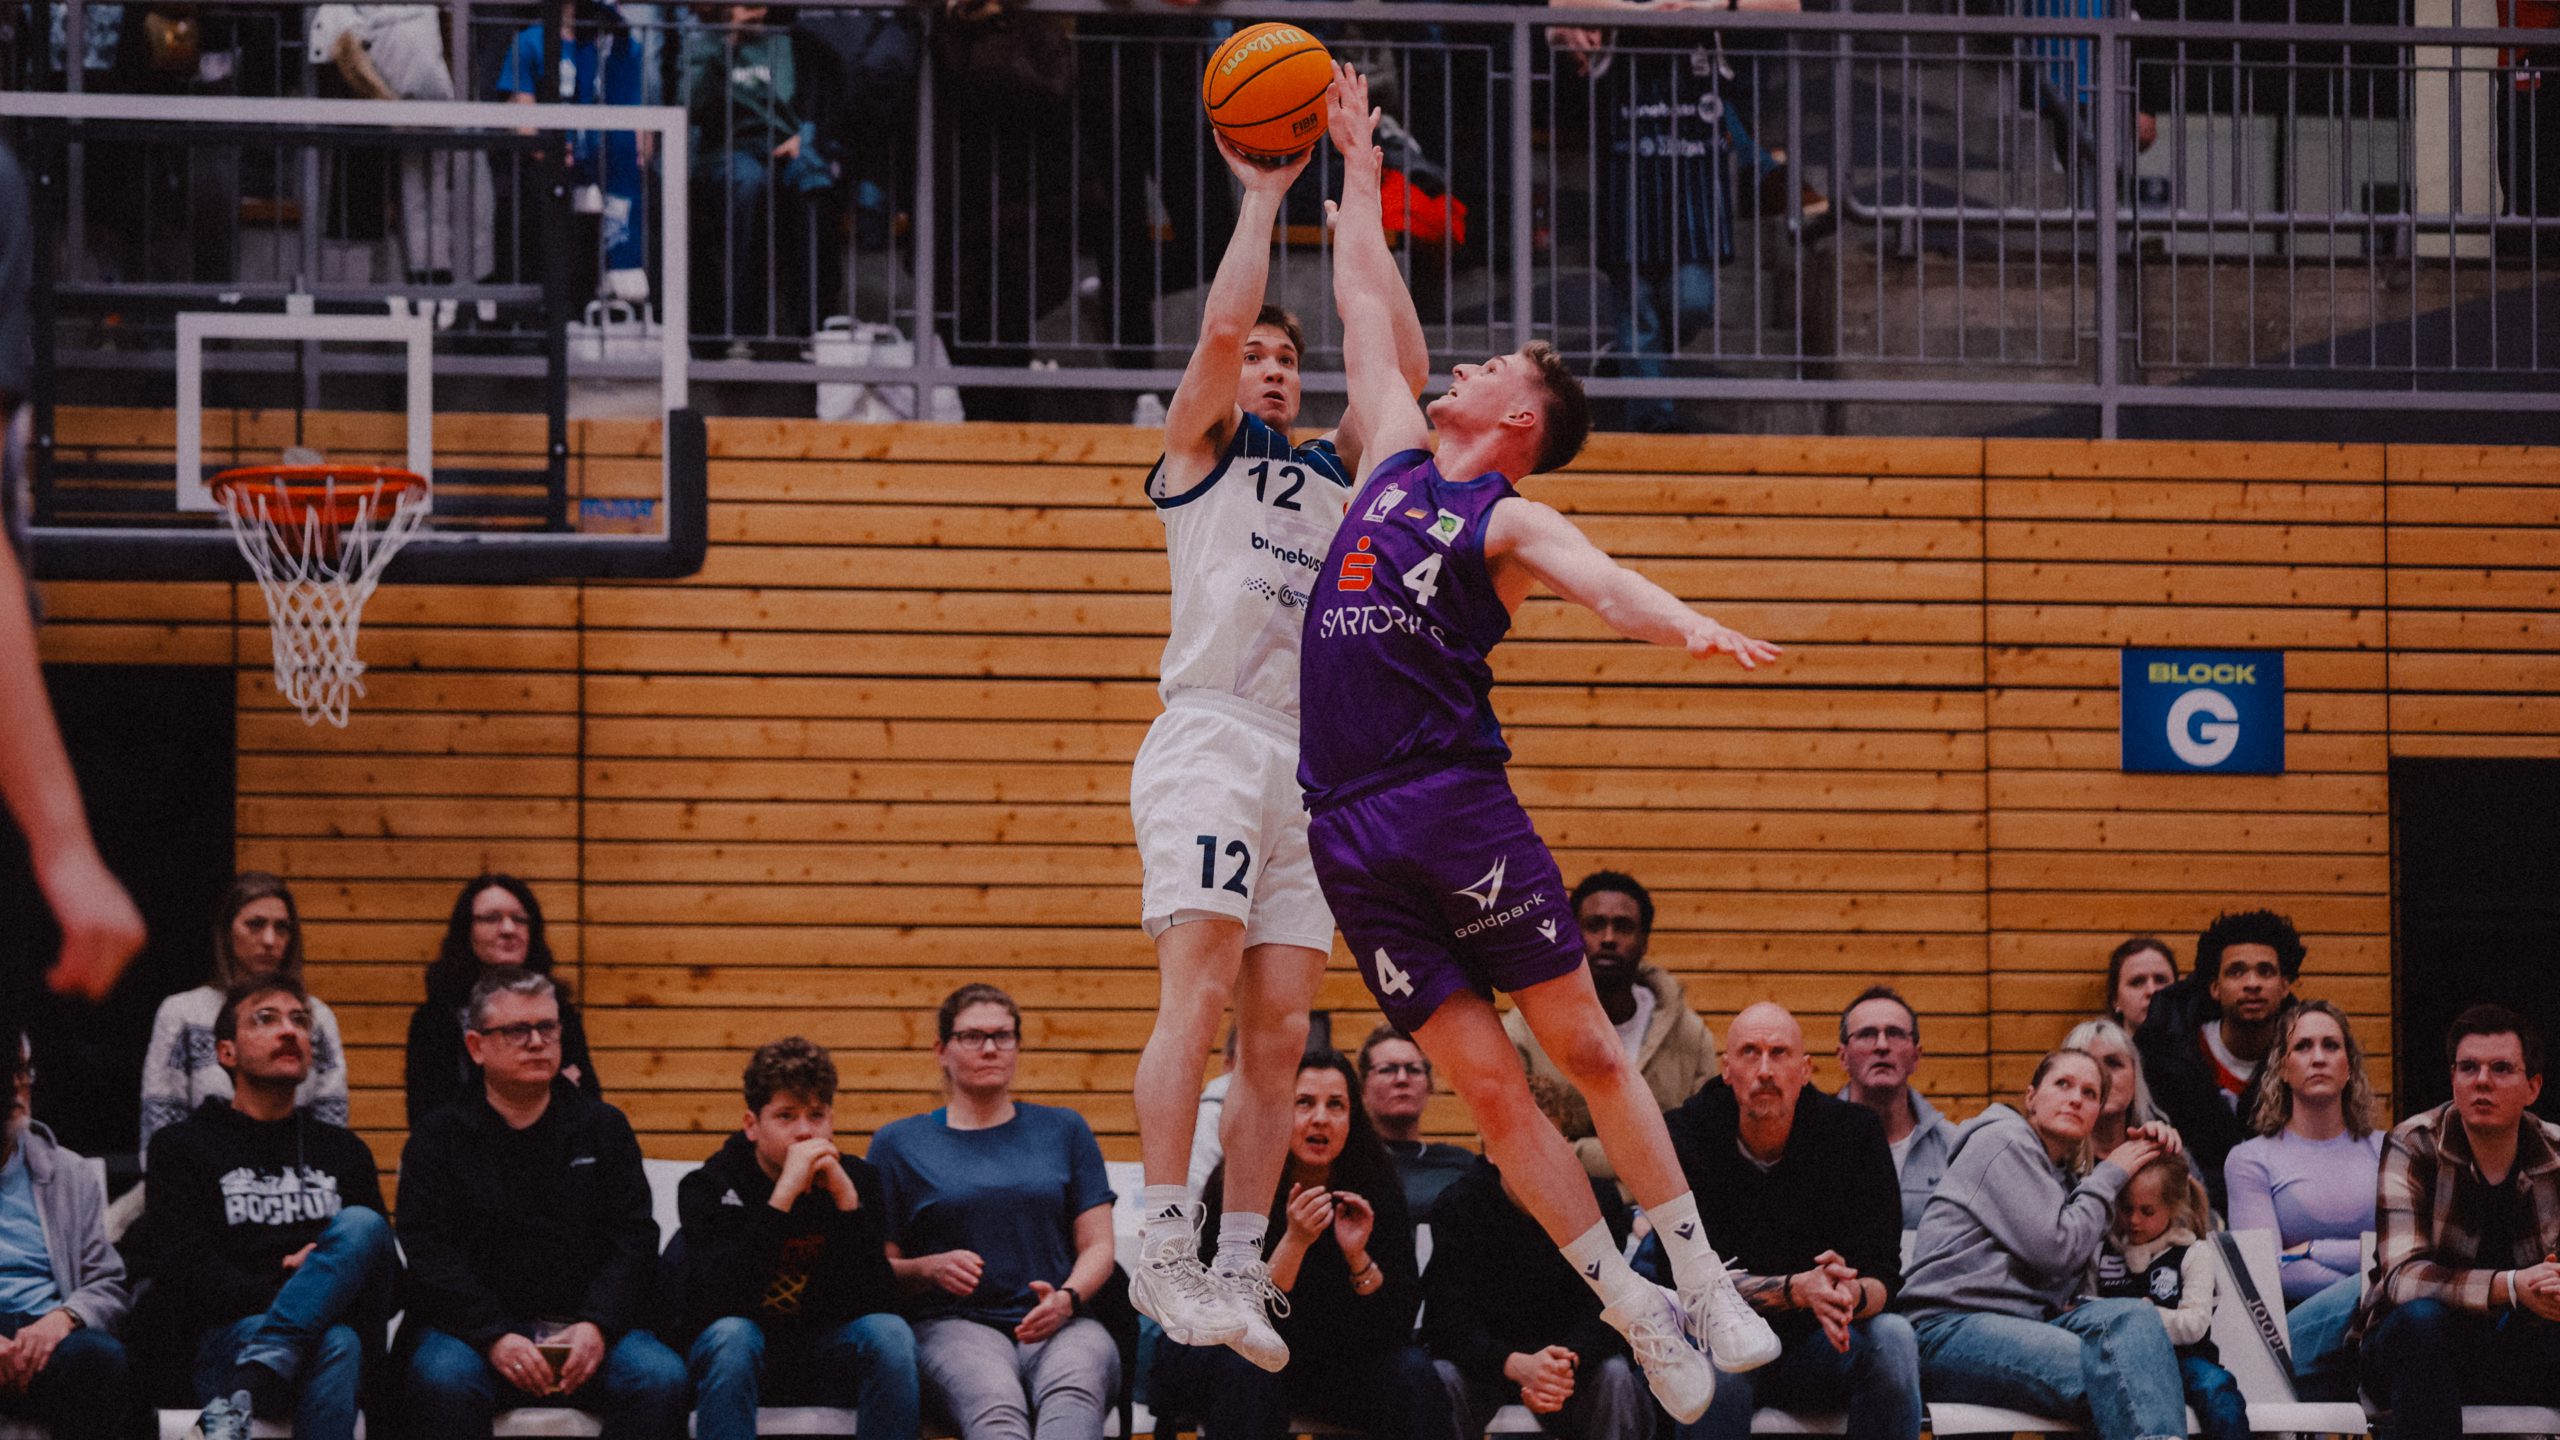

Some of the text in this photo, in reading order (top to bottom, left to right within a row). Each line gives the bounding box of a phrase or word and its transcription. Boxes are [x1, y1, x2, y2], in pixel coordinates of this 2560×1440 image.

[1221, 29, 1307, 76] Wilson
[1292, 112, 1318, 134] FIBA
[1248, 461, 1305, 511] 12
[1402, 552, 1443, 606] 4
[2148, 662, 2256, 685] BLOCK
[2166, 688, 2240, 767] G
[1196, 835, 1251, 899] 12
[1454, 893, 1546, 938] Goldpark
[1374, 947, 1414, 997] 4
[224, 1190, 343, 1226] BOCHUM
